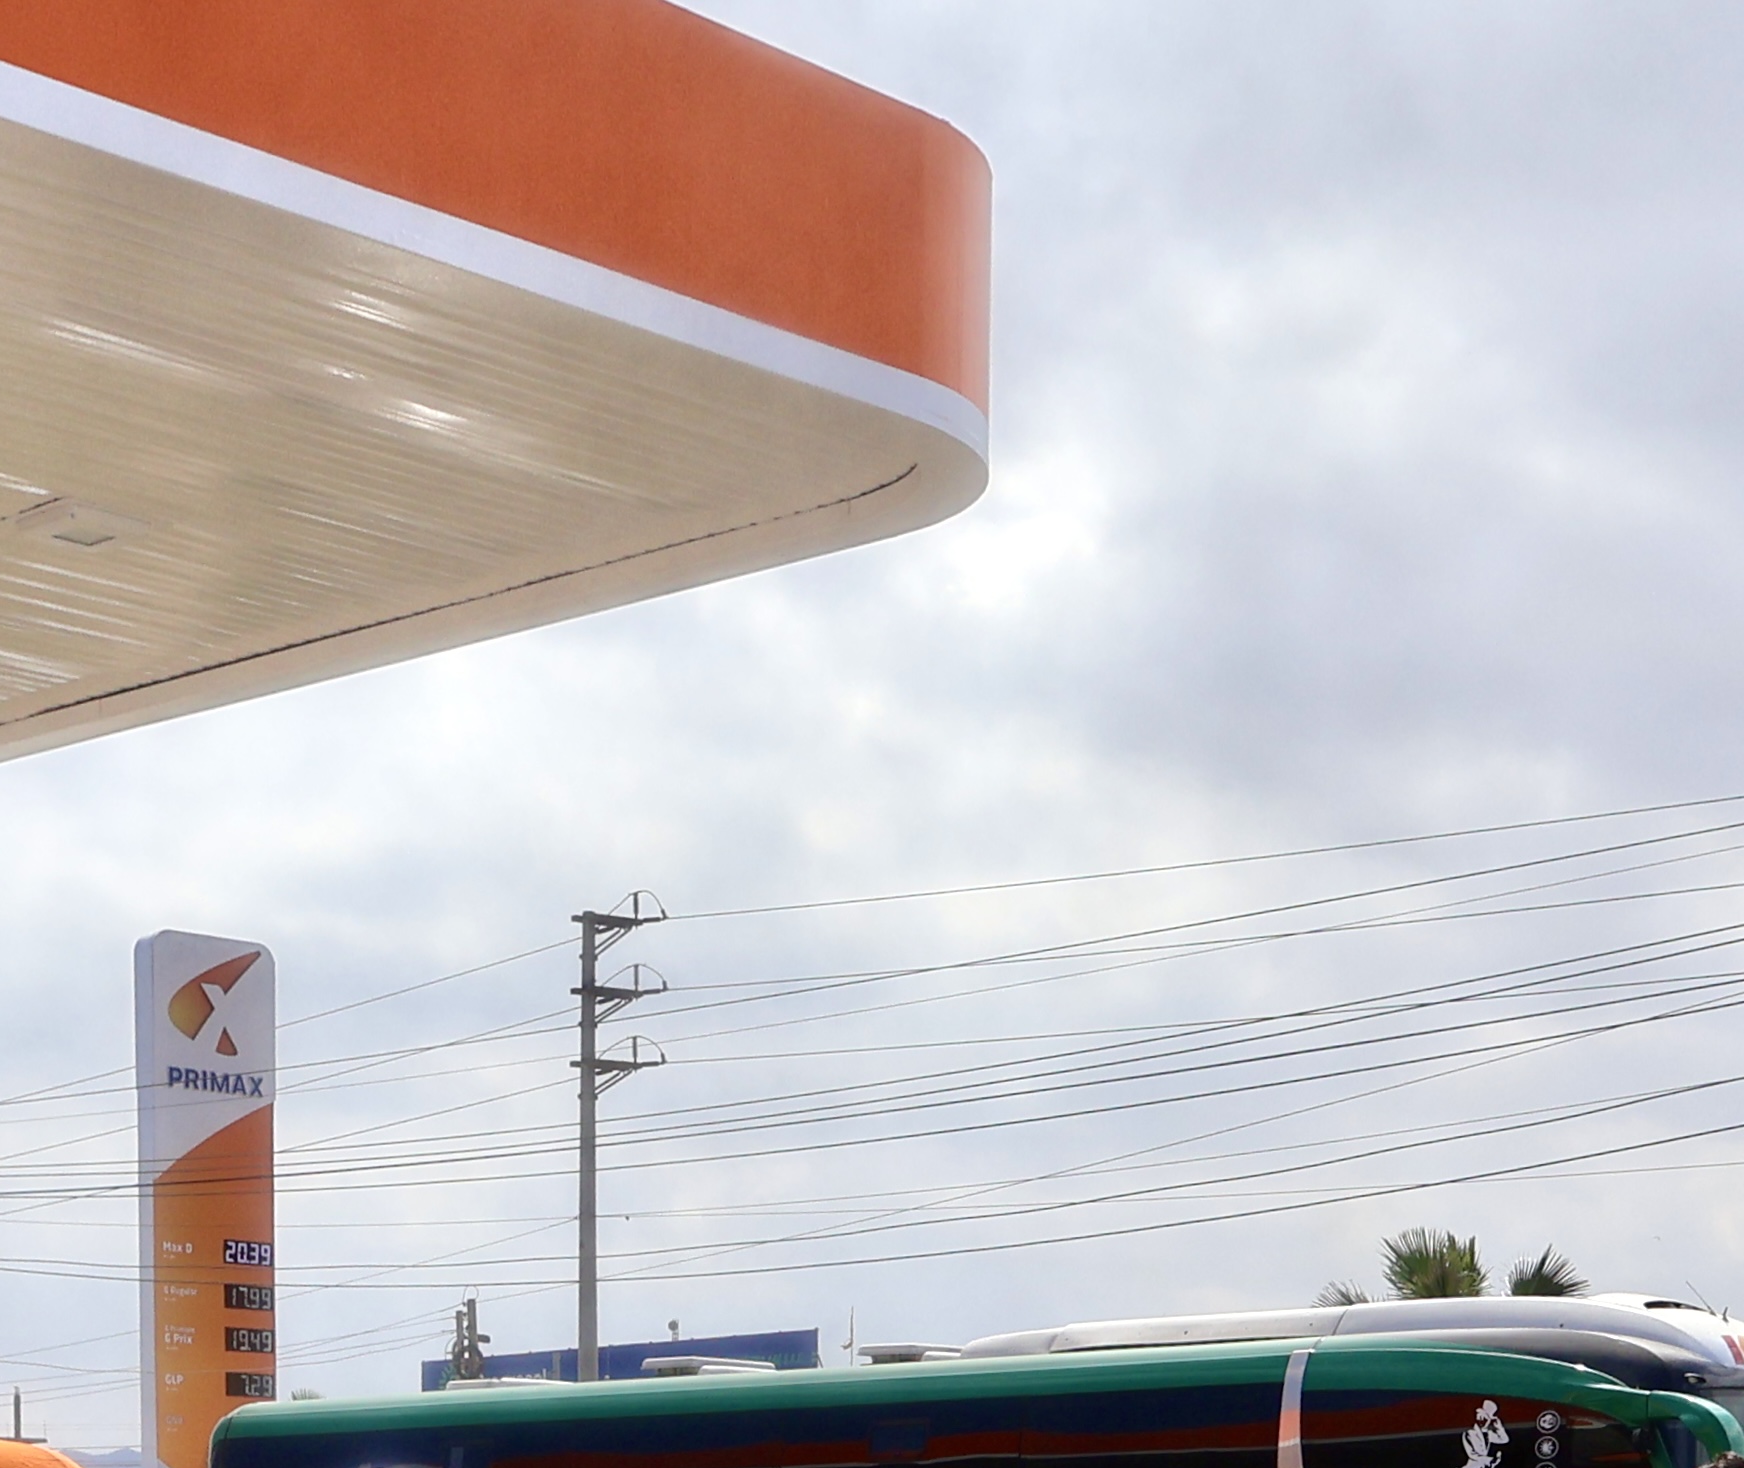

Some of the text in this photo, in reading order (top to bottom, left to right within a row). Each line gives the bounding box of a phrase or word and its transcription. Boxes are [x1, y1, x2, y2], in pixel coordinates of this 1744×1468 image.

[167, 1066, 264, 1098] PRIMAX
[162, 1241, 193, 1254] Max D
[225, 1241, 272, 1266] 20.39
[173, 1334, 193, 1345] Prix
[164, 1373, 184, 1385] GLP
